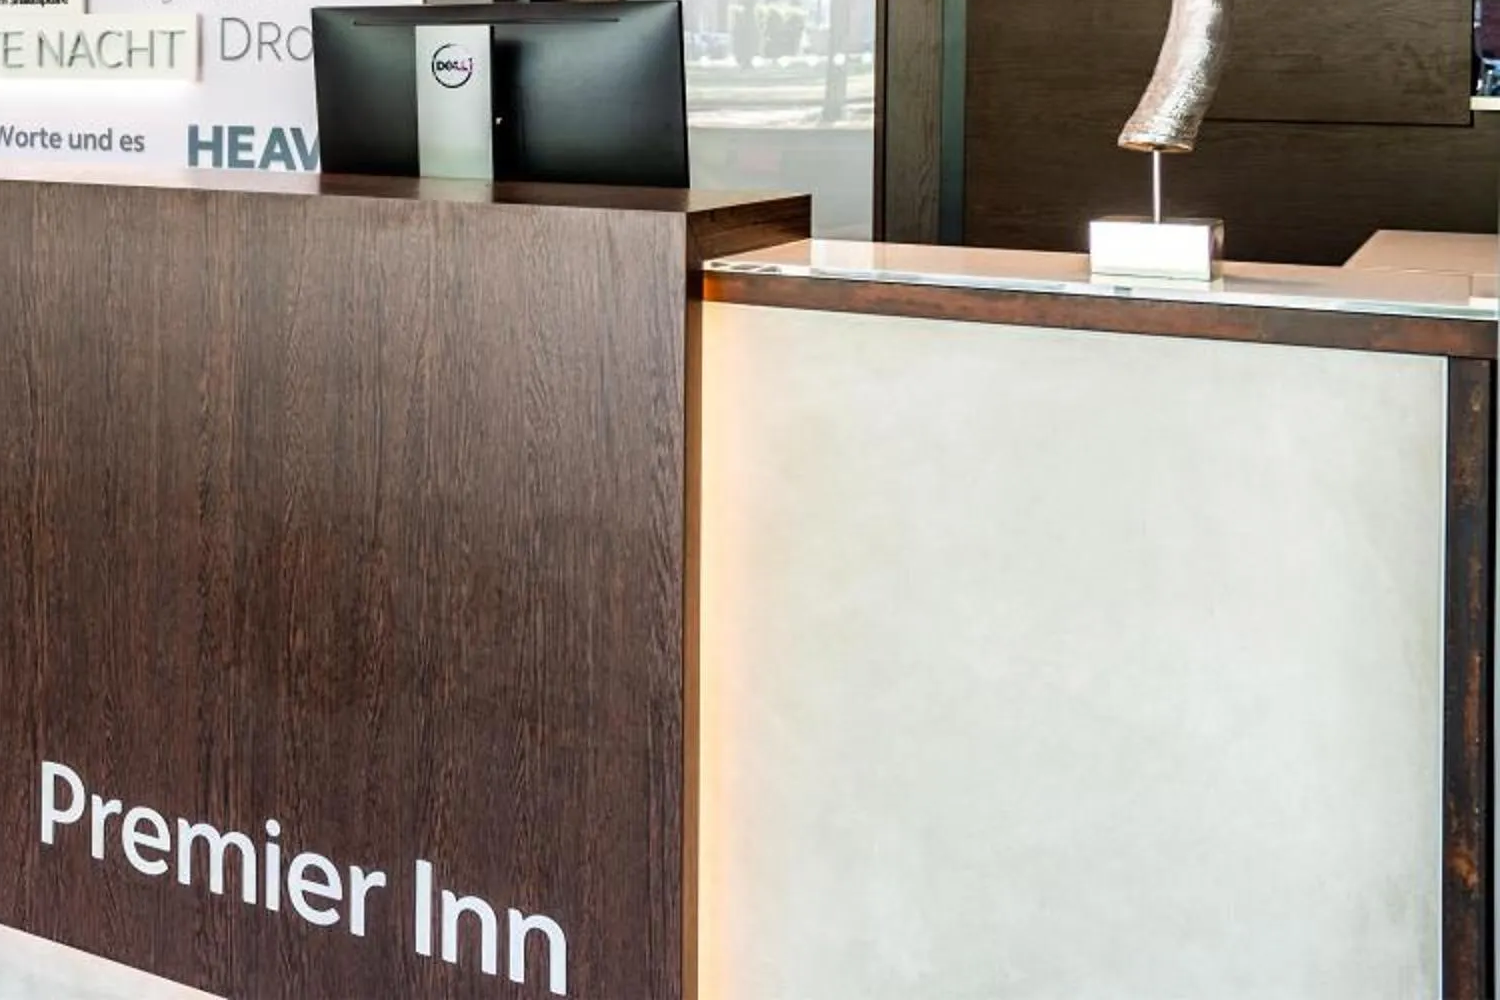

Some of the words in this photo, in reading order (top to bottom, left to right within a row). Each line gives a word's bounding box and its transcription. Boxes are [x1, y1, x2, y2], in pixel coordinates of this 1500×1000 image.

[37, 30, 186, 68] NACHT
[68, 127, 113, 152] und
[120, 132, 144, 152] es
[41, 760, 386, 936] Premier
[415, 859, 567, 996] Inn
